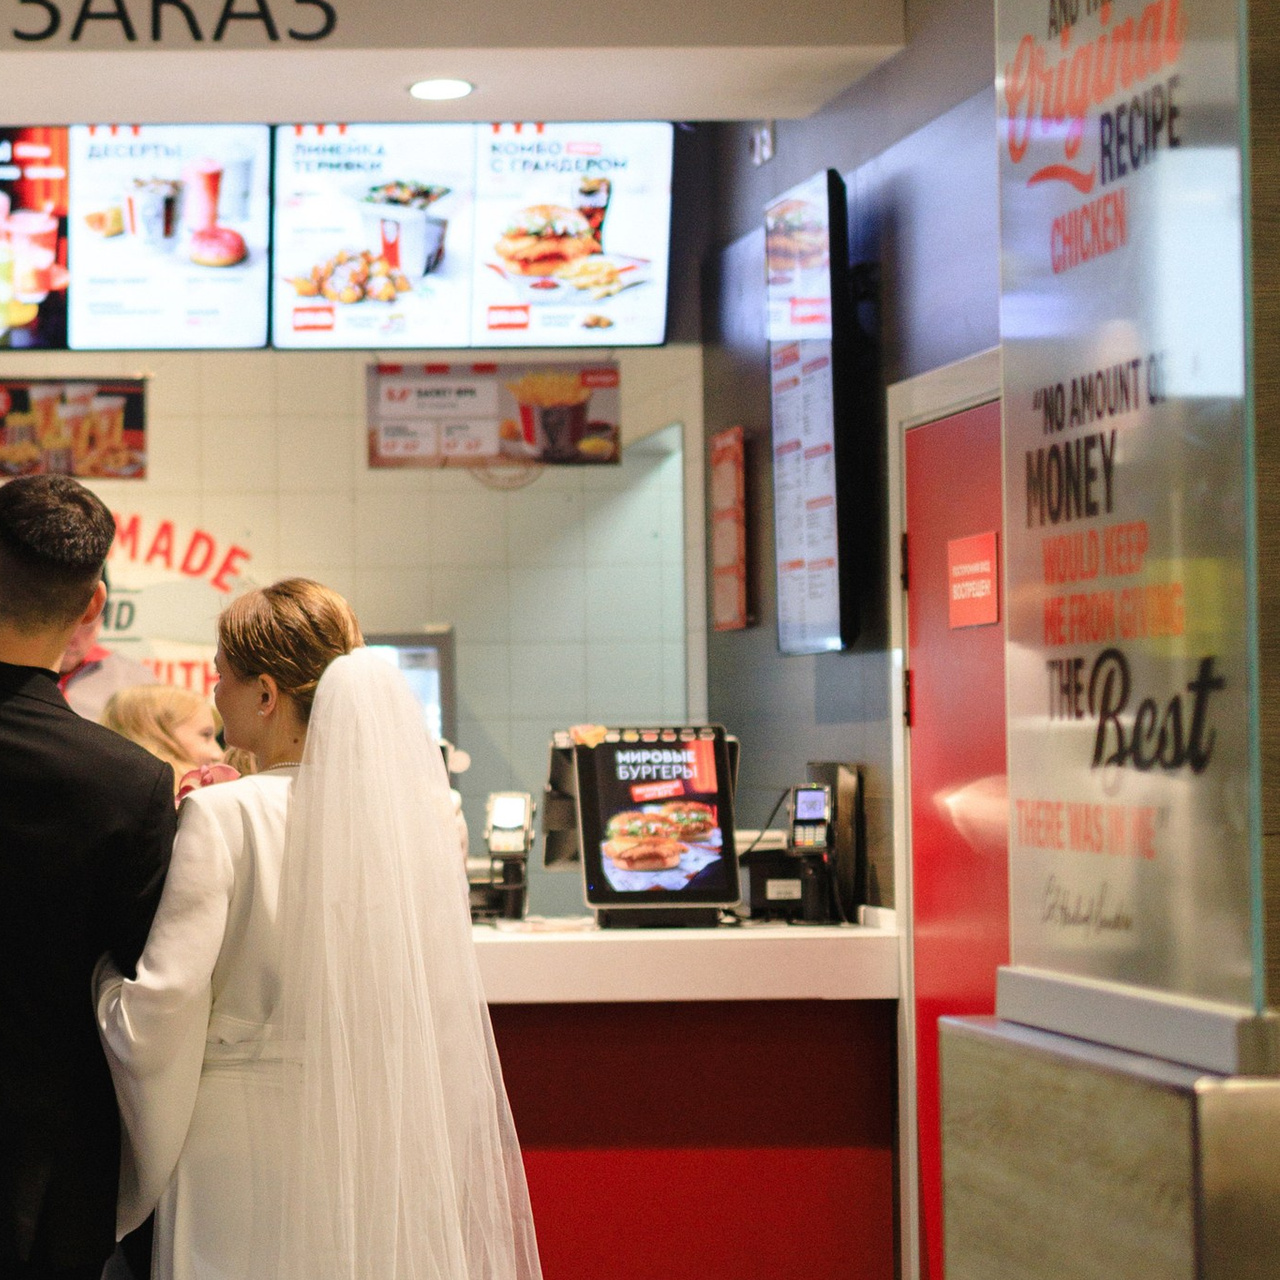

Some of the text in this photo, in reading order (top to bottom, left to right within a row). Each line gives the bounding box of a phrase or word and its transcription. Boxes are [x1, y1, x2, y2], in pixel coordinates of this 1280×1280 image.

[1101, 74, 1180, 187] RECIPE
[1051, 187, 1128, 275] CHICKEN
[1070, 358, 1141, 429] AMOUNT
[1025, 429, 1117, 530] MONEY
[1046, 647, 1227, 775] THE Best
[616, 749, 696, 764] МИРОВЫЕ
[617, 764, 698, 781] БУРГЕРЫ
